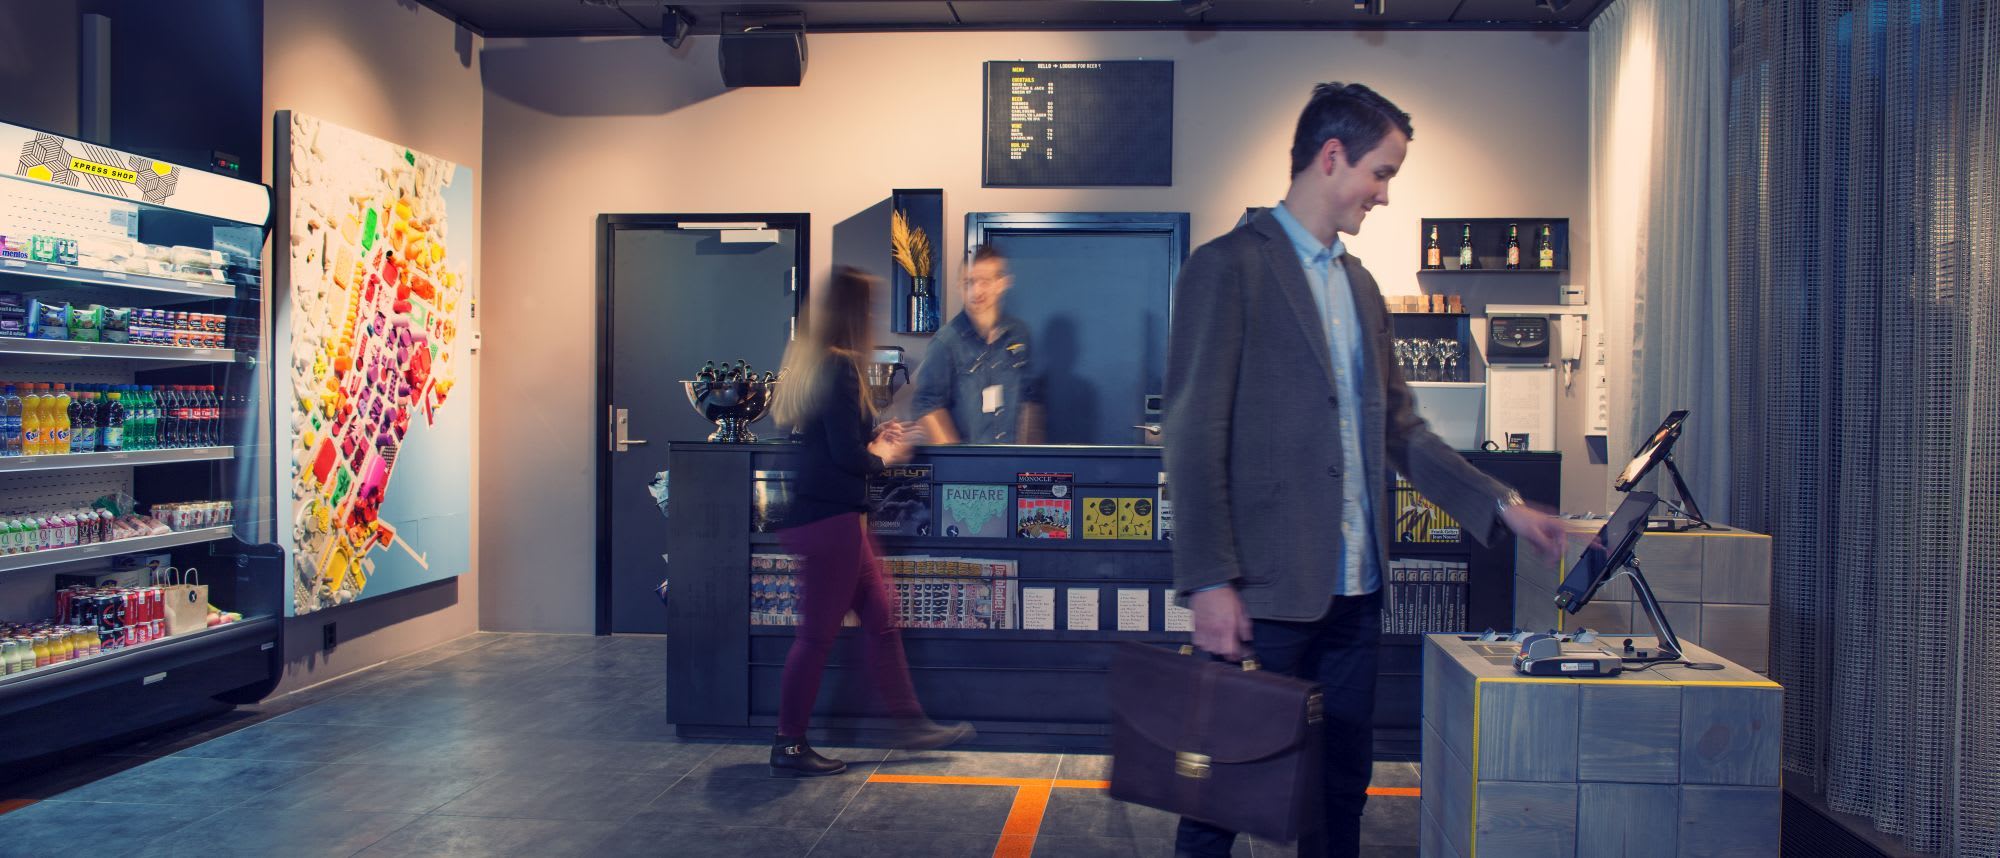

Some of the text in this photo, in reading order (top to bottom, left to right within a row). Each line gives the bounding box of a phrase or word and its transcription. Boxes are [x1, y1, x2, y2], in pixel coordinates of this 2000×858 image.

[74, 162, 134, 180] XPRESS SHOP
[2, 250, 28, 259] mentos
[946, 488, 1004, 501] FANFARE
[995, 565, 1006, 609] Dabladet
